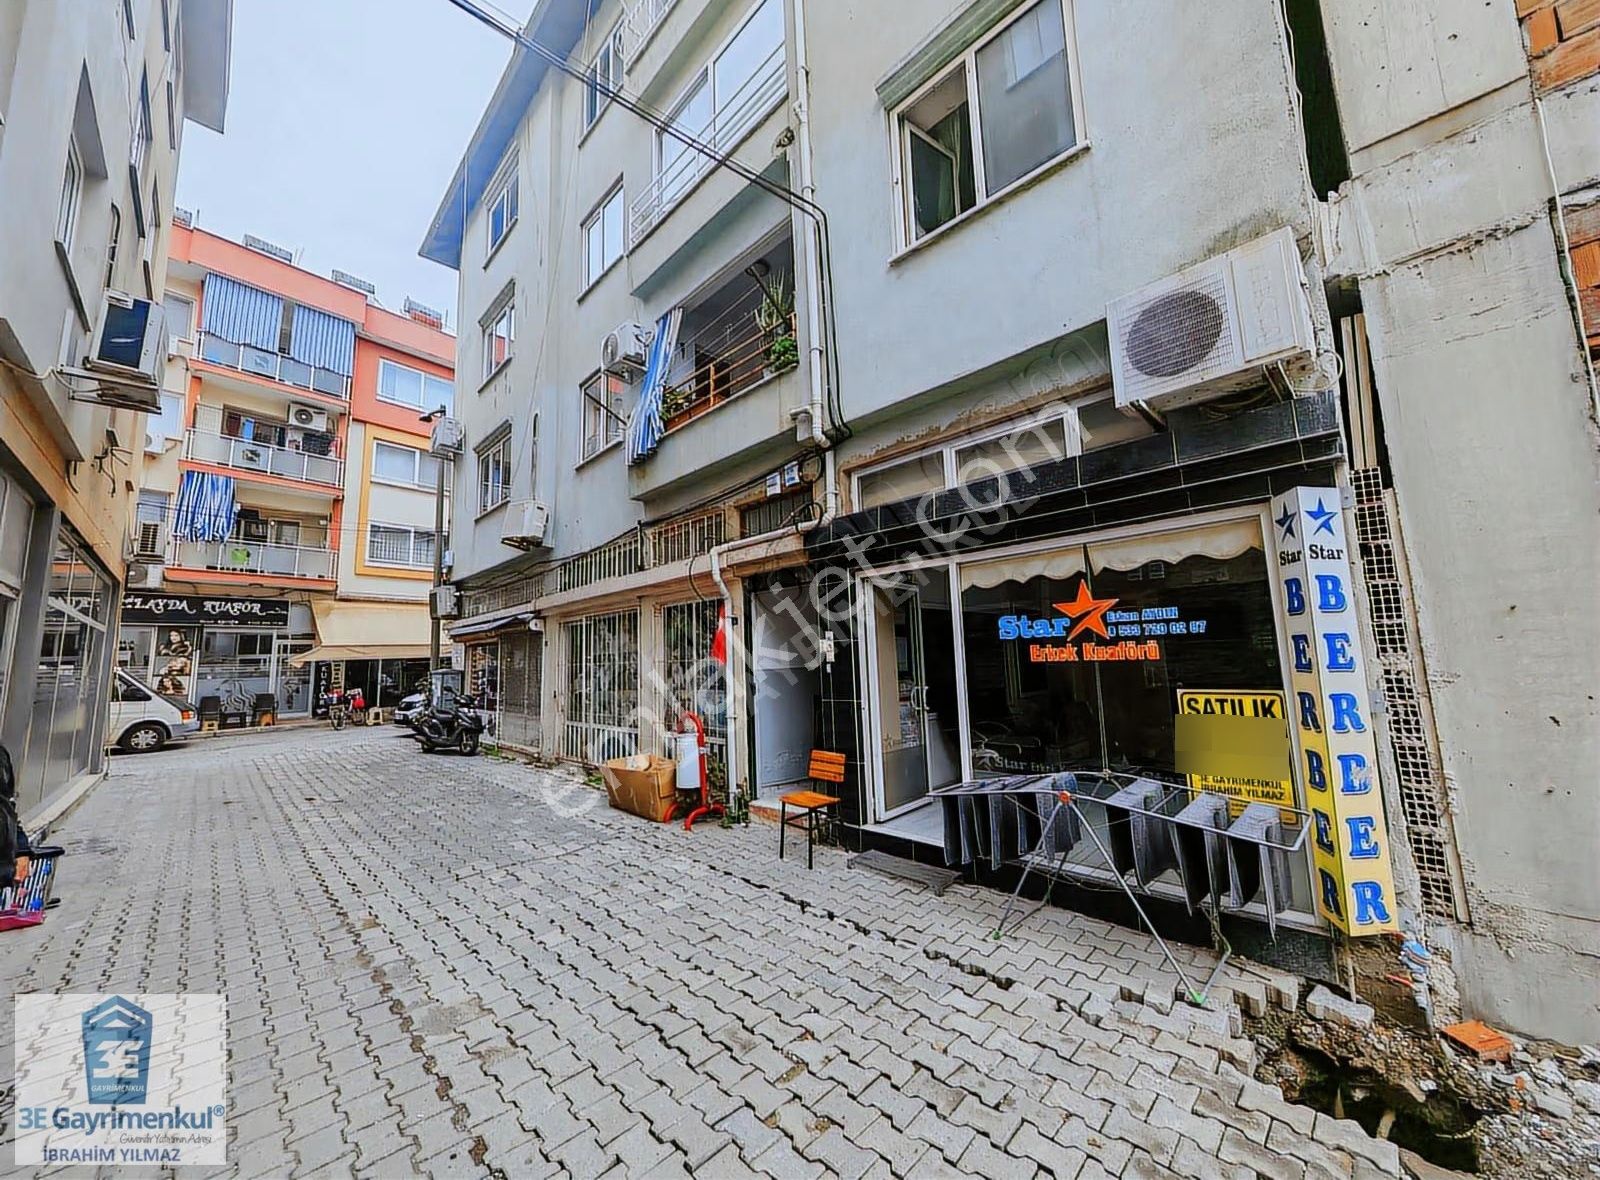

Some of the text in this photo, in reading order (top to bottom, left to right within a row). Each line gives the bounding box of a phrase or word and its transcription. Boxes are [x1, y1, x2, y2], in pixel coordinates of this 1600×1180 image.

[1280, 550, 1302, 566] Star
[1309, 544, 1344, 560] Star
[998, 614, 1070, 640] Star
[1030, 640, 1161, 662] Erkek Kuaförü
[1187, 697, 1278, 719] SATILIK
[1284, 578, 1345, 921] BERBER
[1315, 574, 1393, 925] BERBER
[1247, 788, 1286, 801] YILMAZ
